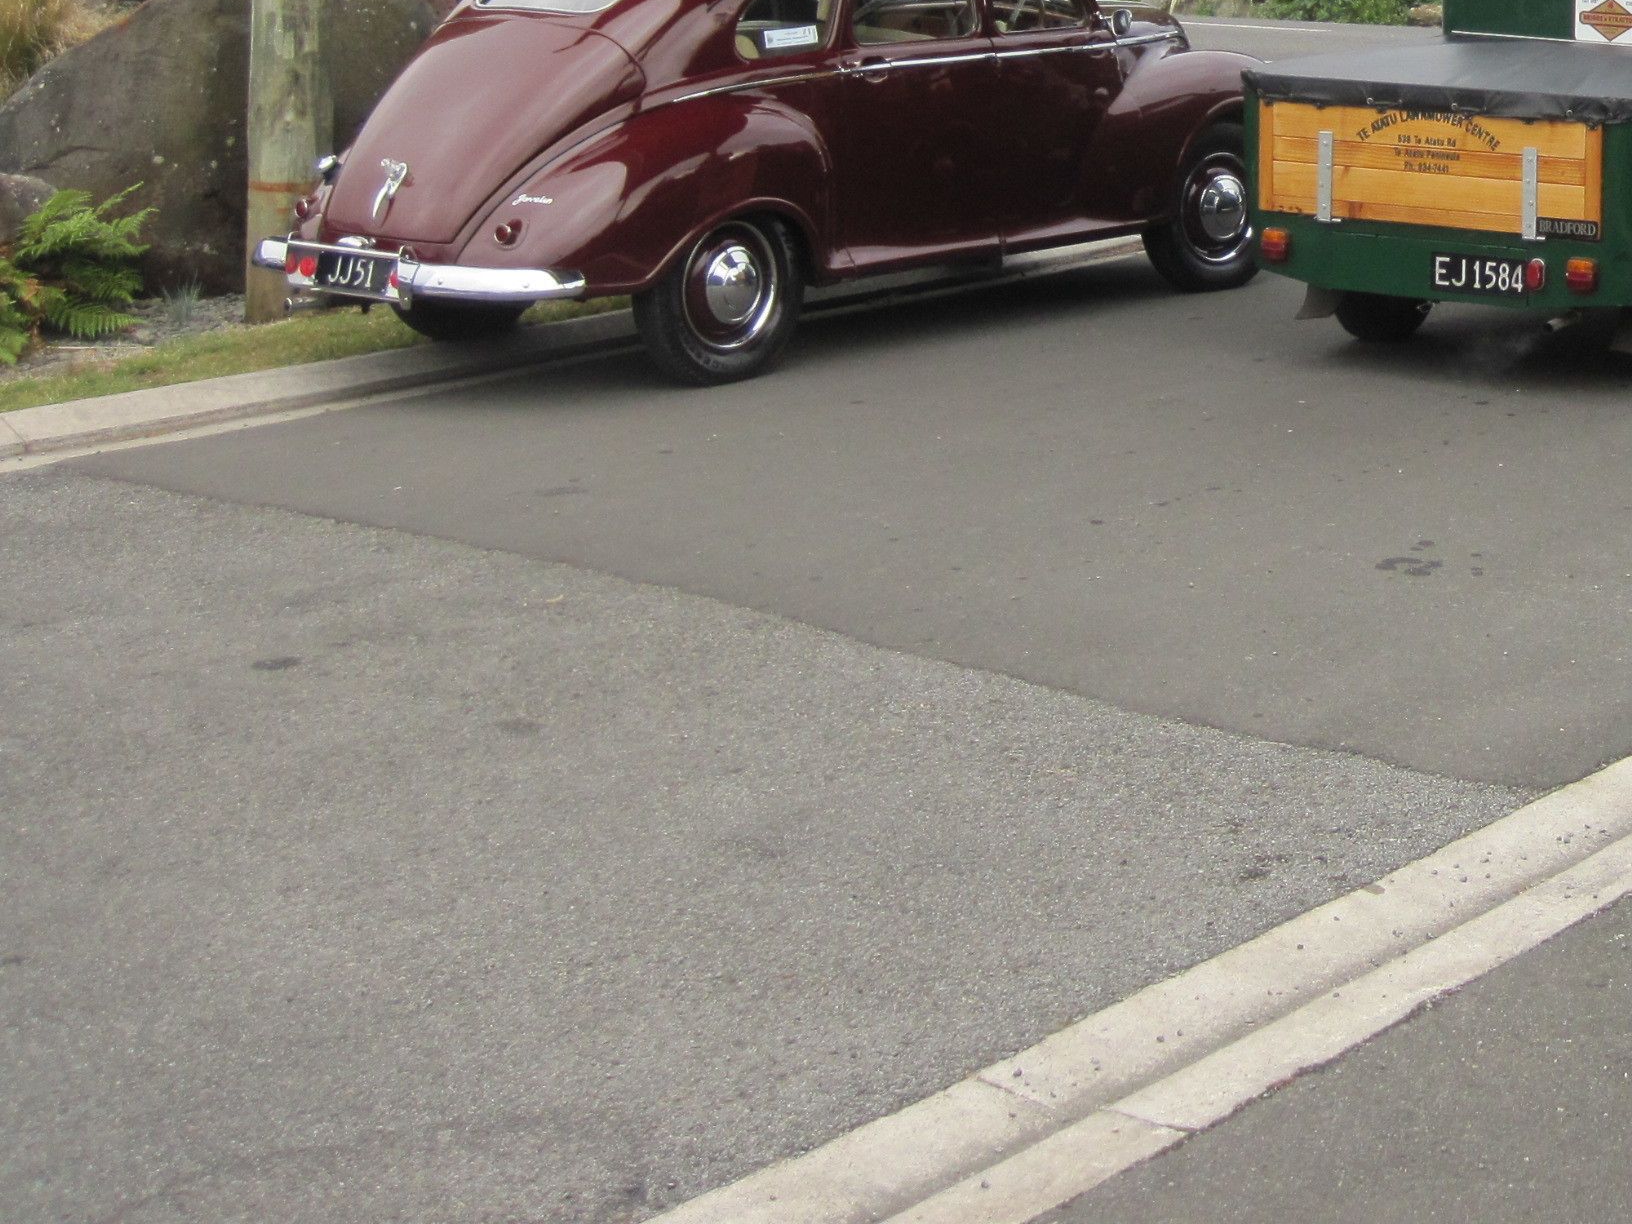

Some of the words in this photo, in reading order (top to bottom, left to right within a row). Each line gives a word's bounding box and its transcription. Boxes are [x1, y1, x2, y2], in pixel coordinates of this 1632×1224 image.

[1356, 128, 1370, 141] TE
[1465, 121, 1501, 151] CENTRE
[1539, 220, 1596, 236] BRADFORD
[328, 256, 374, 287] JJ51
[1435, 256, 1524, 293] EJ1584
